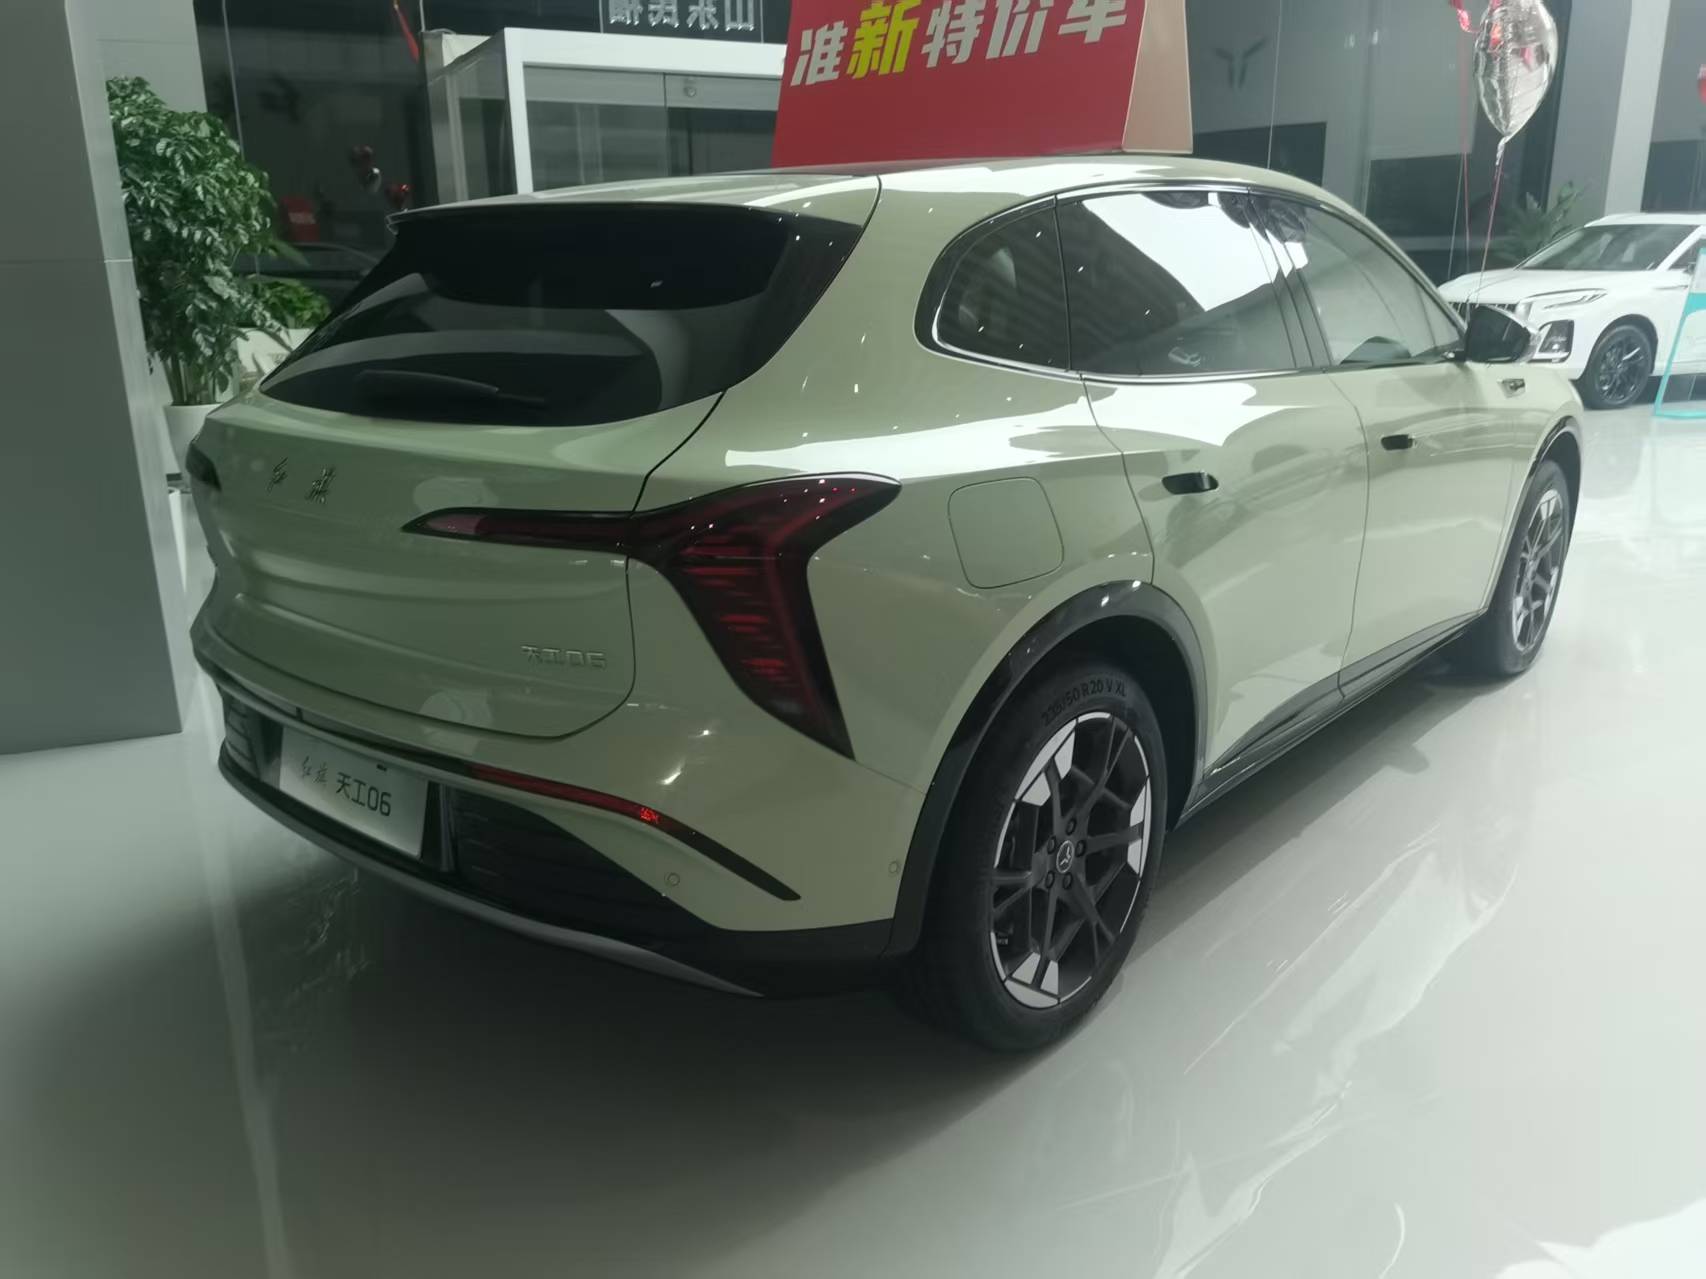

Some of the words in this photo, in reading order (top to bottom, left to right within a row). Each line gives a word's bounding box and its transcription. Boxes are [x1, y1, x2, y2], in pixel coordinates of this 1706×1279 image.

[790, 0, 1128, 87] 准新特价车
[336, 771, 392, 817] 天工06
